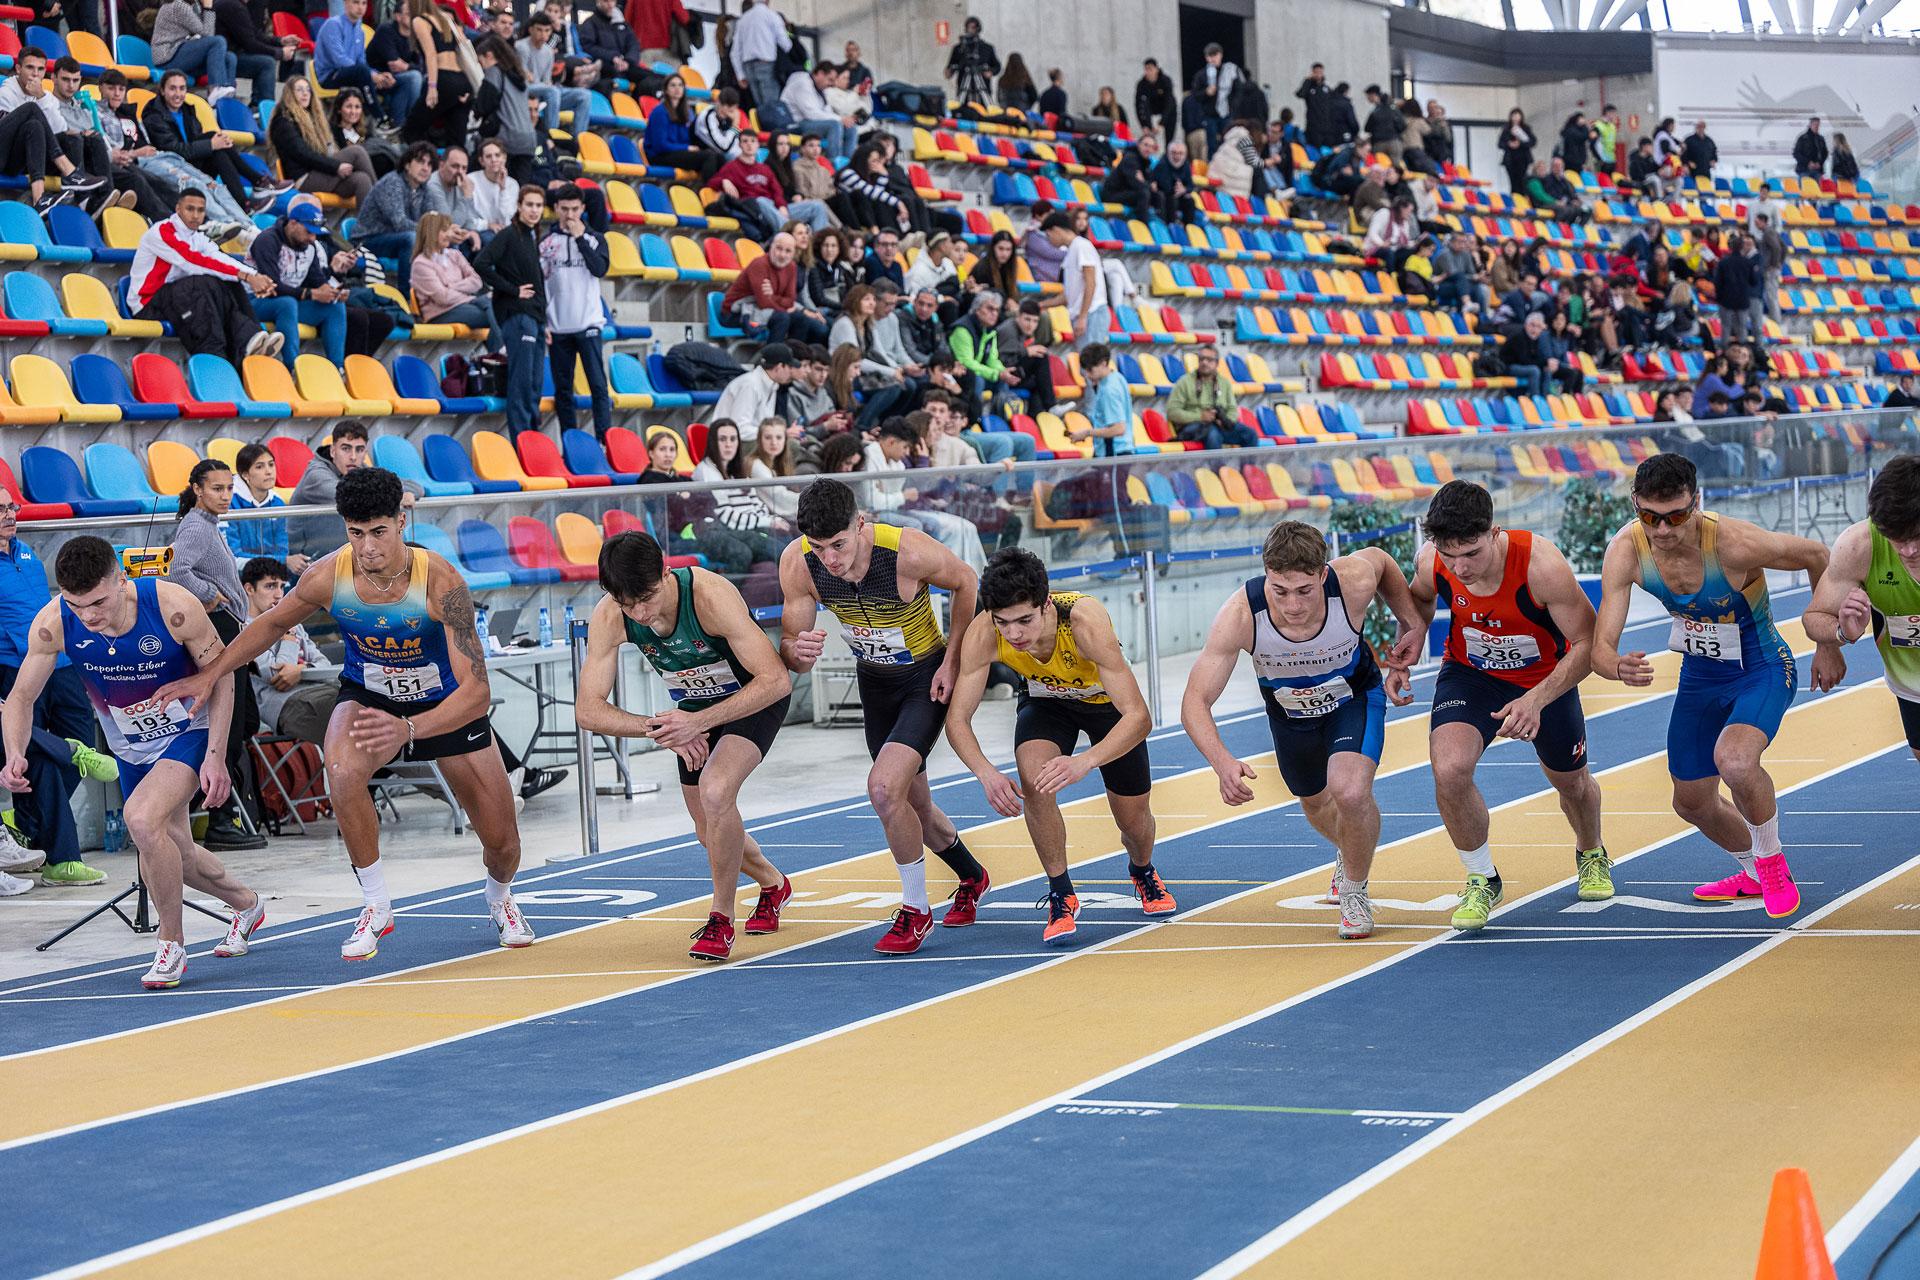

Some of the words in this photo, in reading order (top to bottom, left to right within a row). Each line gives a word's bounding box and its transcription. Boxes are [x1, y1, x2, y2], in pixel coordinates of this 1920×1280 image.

[1457, 596, 1466, 605] S
[852, 627, 884, 638] GOfit
[1684, 620, 1717, 632] GOfit
[1481, 633, 1515, 646] GOfit
[1482, 646, 1522, 662] 236
[1684, 637, 1722, 658] 153
[83, 662, 135, 673] Deportivo
[137, 660, 167, 672] Eibar
[1481, 658, 1526, 671] Joma
[384, 678, 421, 695] 151
[680, 676, 718, 689] 101
[685, 685, 727, 698] Joma
[1297, 693, 1337, 709] 164
[131, 712, 171, 732] 193
[139, 724, 181, 742] Joma
